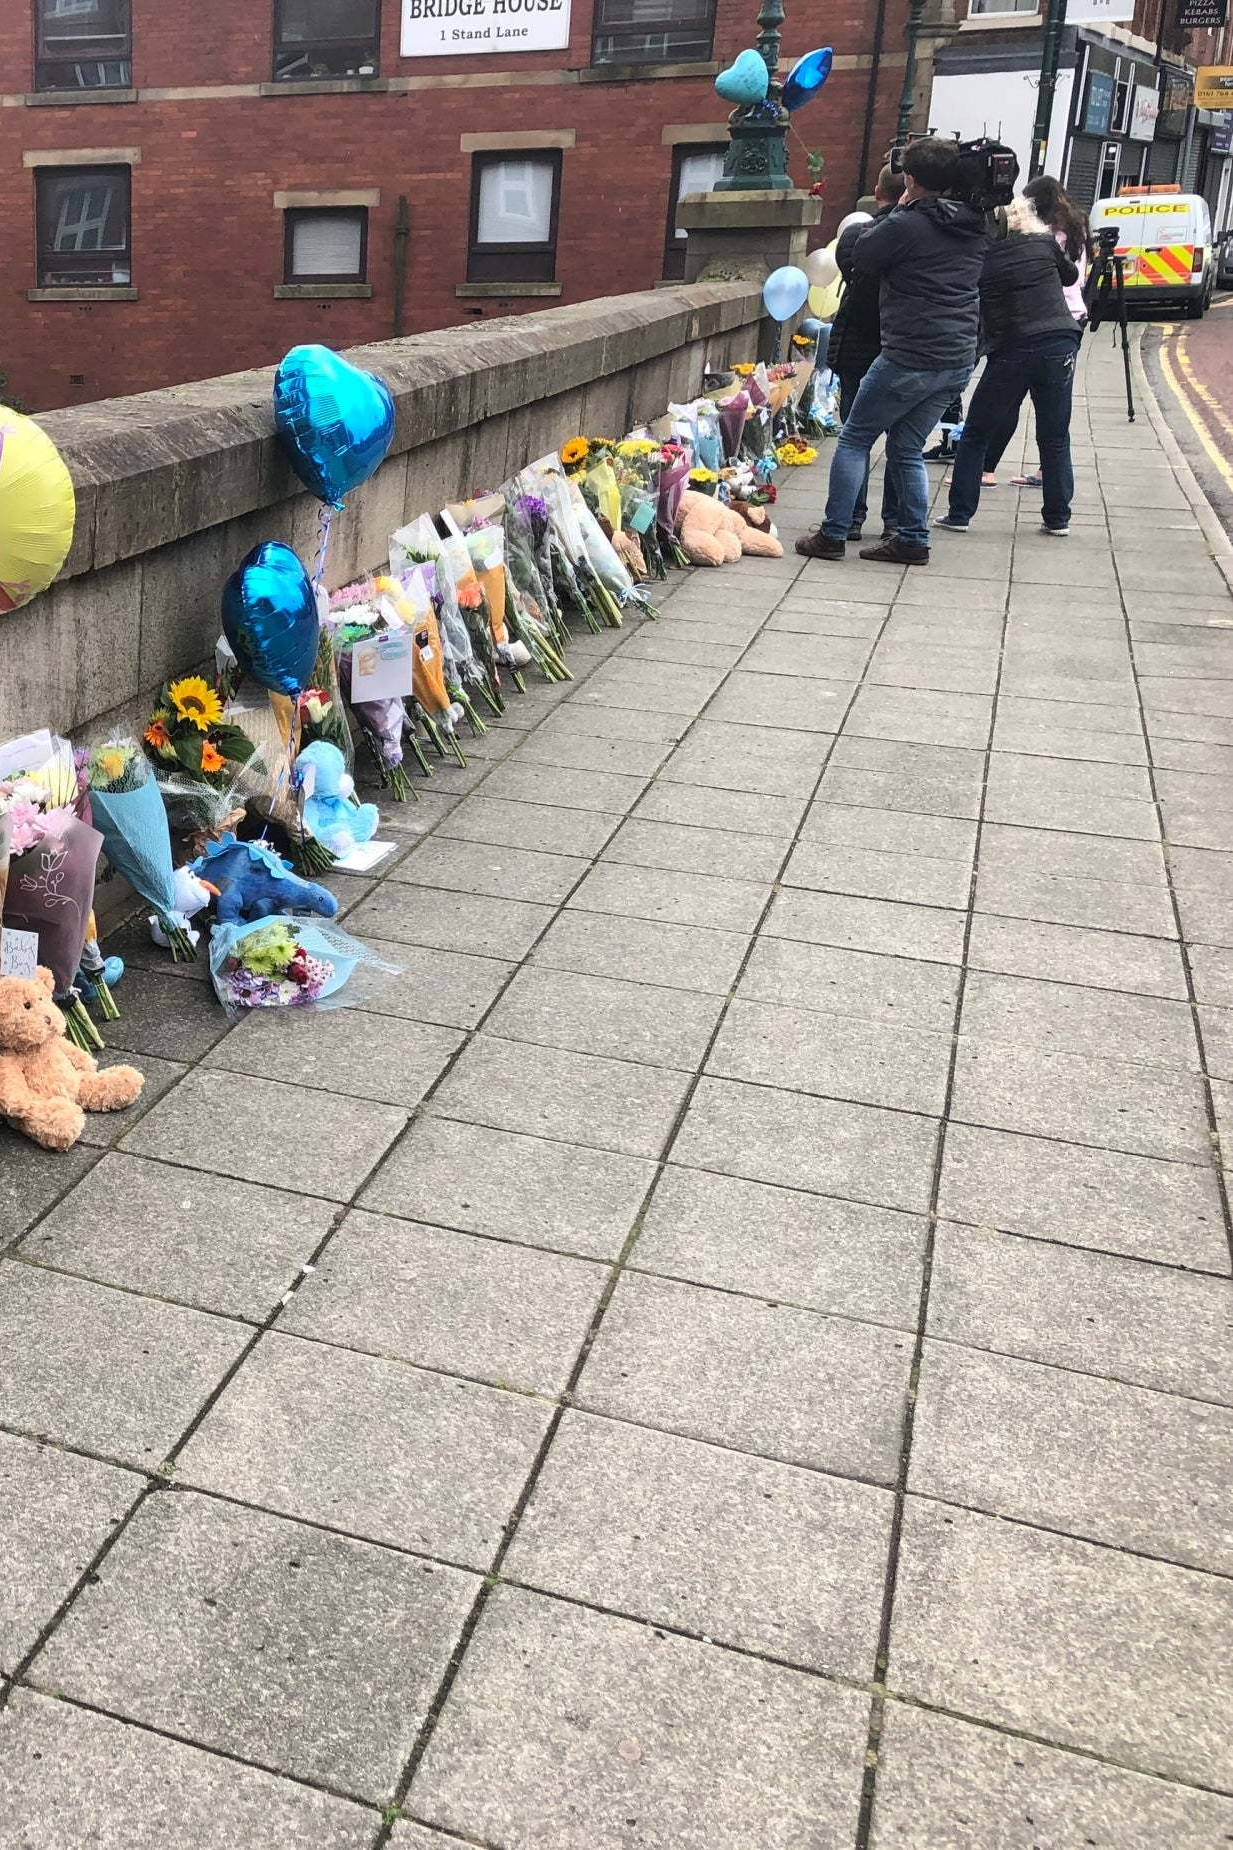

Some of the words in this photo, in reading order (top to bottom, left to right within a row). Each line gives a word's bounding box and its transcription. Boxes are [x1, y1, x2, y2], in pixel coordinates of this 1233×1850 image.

[409, 0, 486, 19] BRIDGE
[492, 0, 563, 14] HOUSE
[1179, 16, 1221, 25] BURGERS
[440, 30, 446, 40] 1
[451, 27, 491, 40] Stand
[496, 27, 529, 38] Lane
[1104, 204, 1187, 216] POLICE
